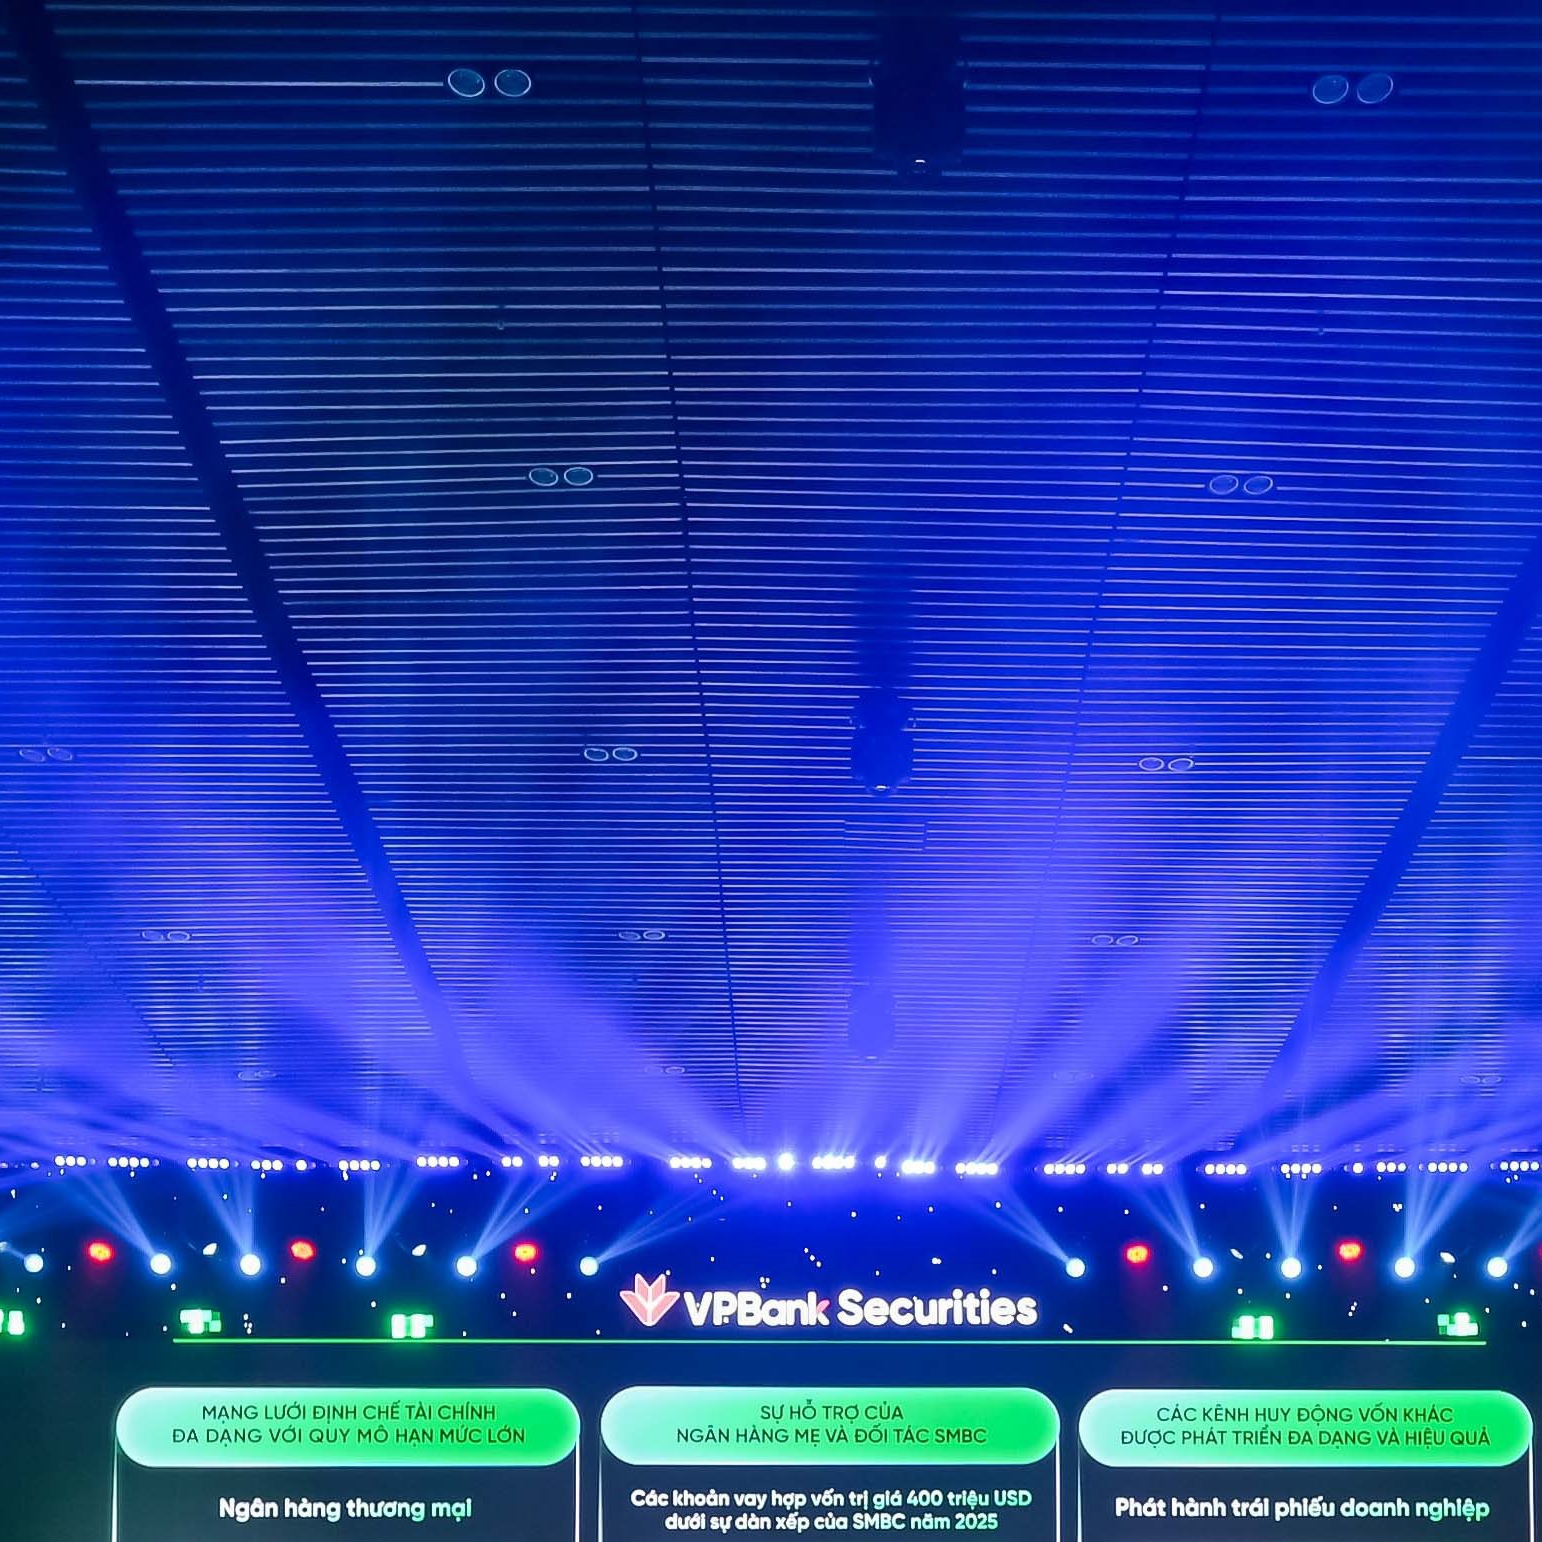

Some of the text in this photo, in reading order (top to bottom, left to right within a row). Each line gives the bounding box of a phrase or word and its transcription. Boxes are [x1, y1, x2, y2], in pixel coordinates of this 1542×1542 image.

[683, 1288, 1038, 1327] VPBank Securities
[203, 1401, 495, 1424] MẠNG LƯỚI ĐỊNH CHẾ TÀI CHÍNH
[760, 1399, 903, 1423] SỰ HỖ TRỢ CỦA
[1157, 1403, 1453, 1427] CÁC KÊNH HUY ĐỘNG VỐN KHÁC
[173, 1425, 525, 1448] ĐA DẠNG VỚI QUY MÔ HẠN MỨC LỚN
[677, 1424, 986, 1446] NGÂN HÀNG MẸ VÀ ĐỐI TÁC SMBC
[1121, 1425, 1490, 1450] ĐƯỢC PHÁT TRIỂN ĐA DẠNG VÀ HIỆU QUẢ
[219, 1497, 472, 1522] Ngân hàng thương mại
[630, 1488, 1031, 1511] Các khoản vay hợp vốn trị giá 400 triệu USD
[1115, 1496, 1490, 1521] Phát hành trái phiếu doanh nghiệp
[665, 1511, 998, 1534] dưới sự dàn xếp của SMBC năm 2025
